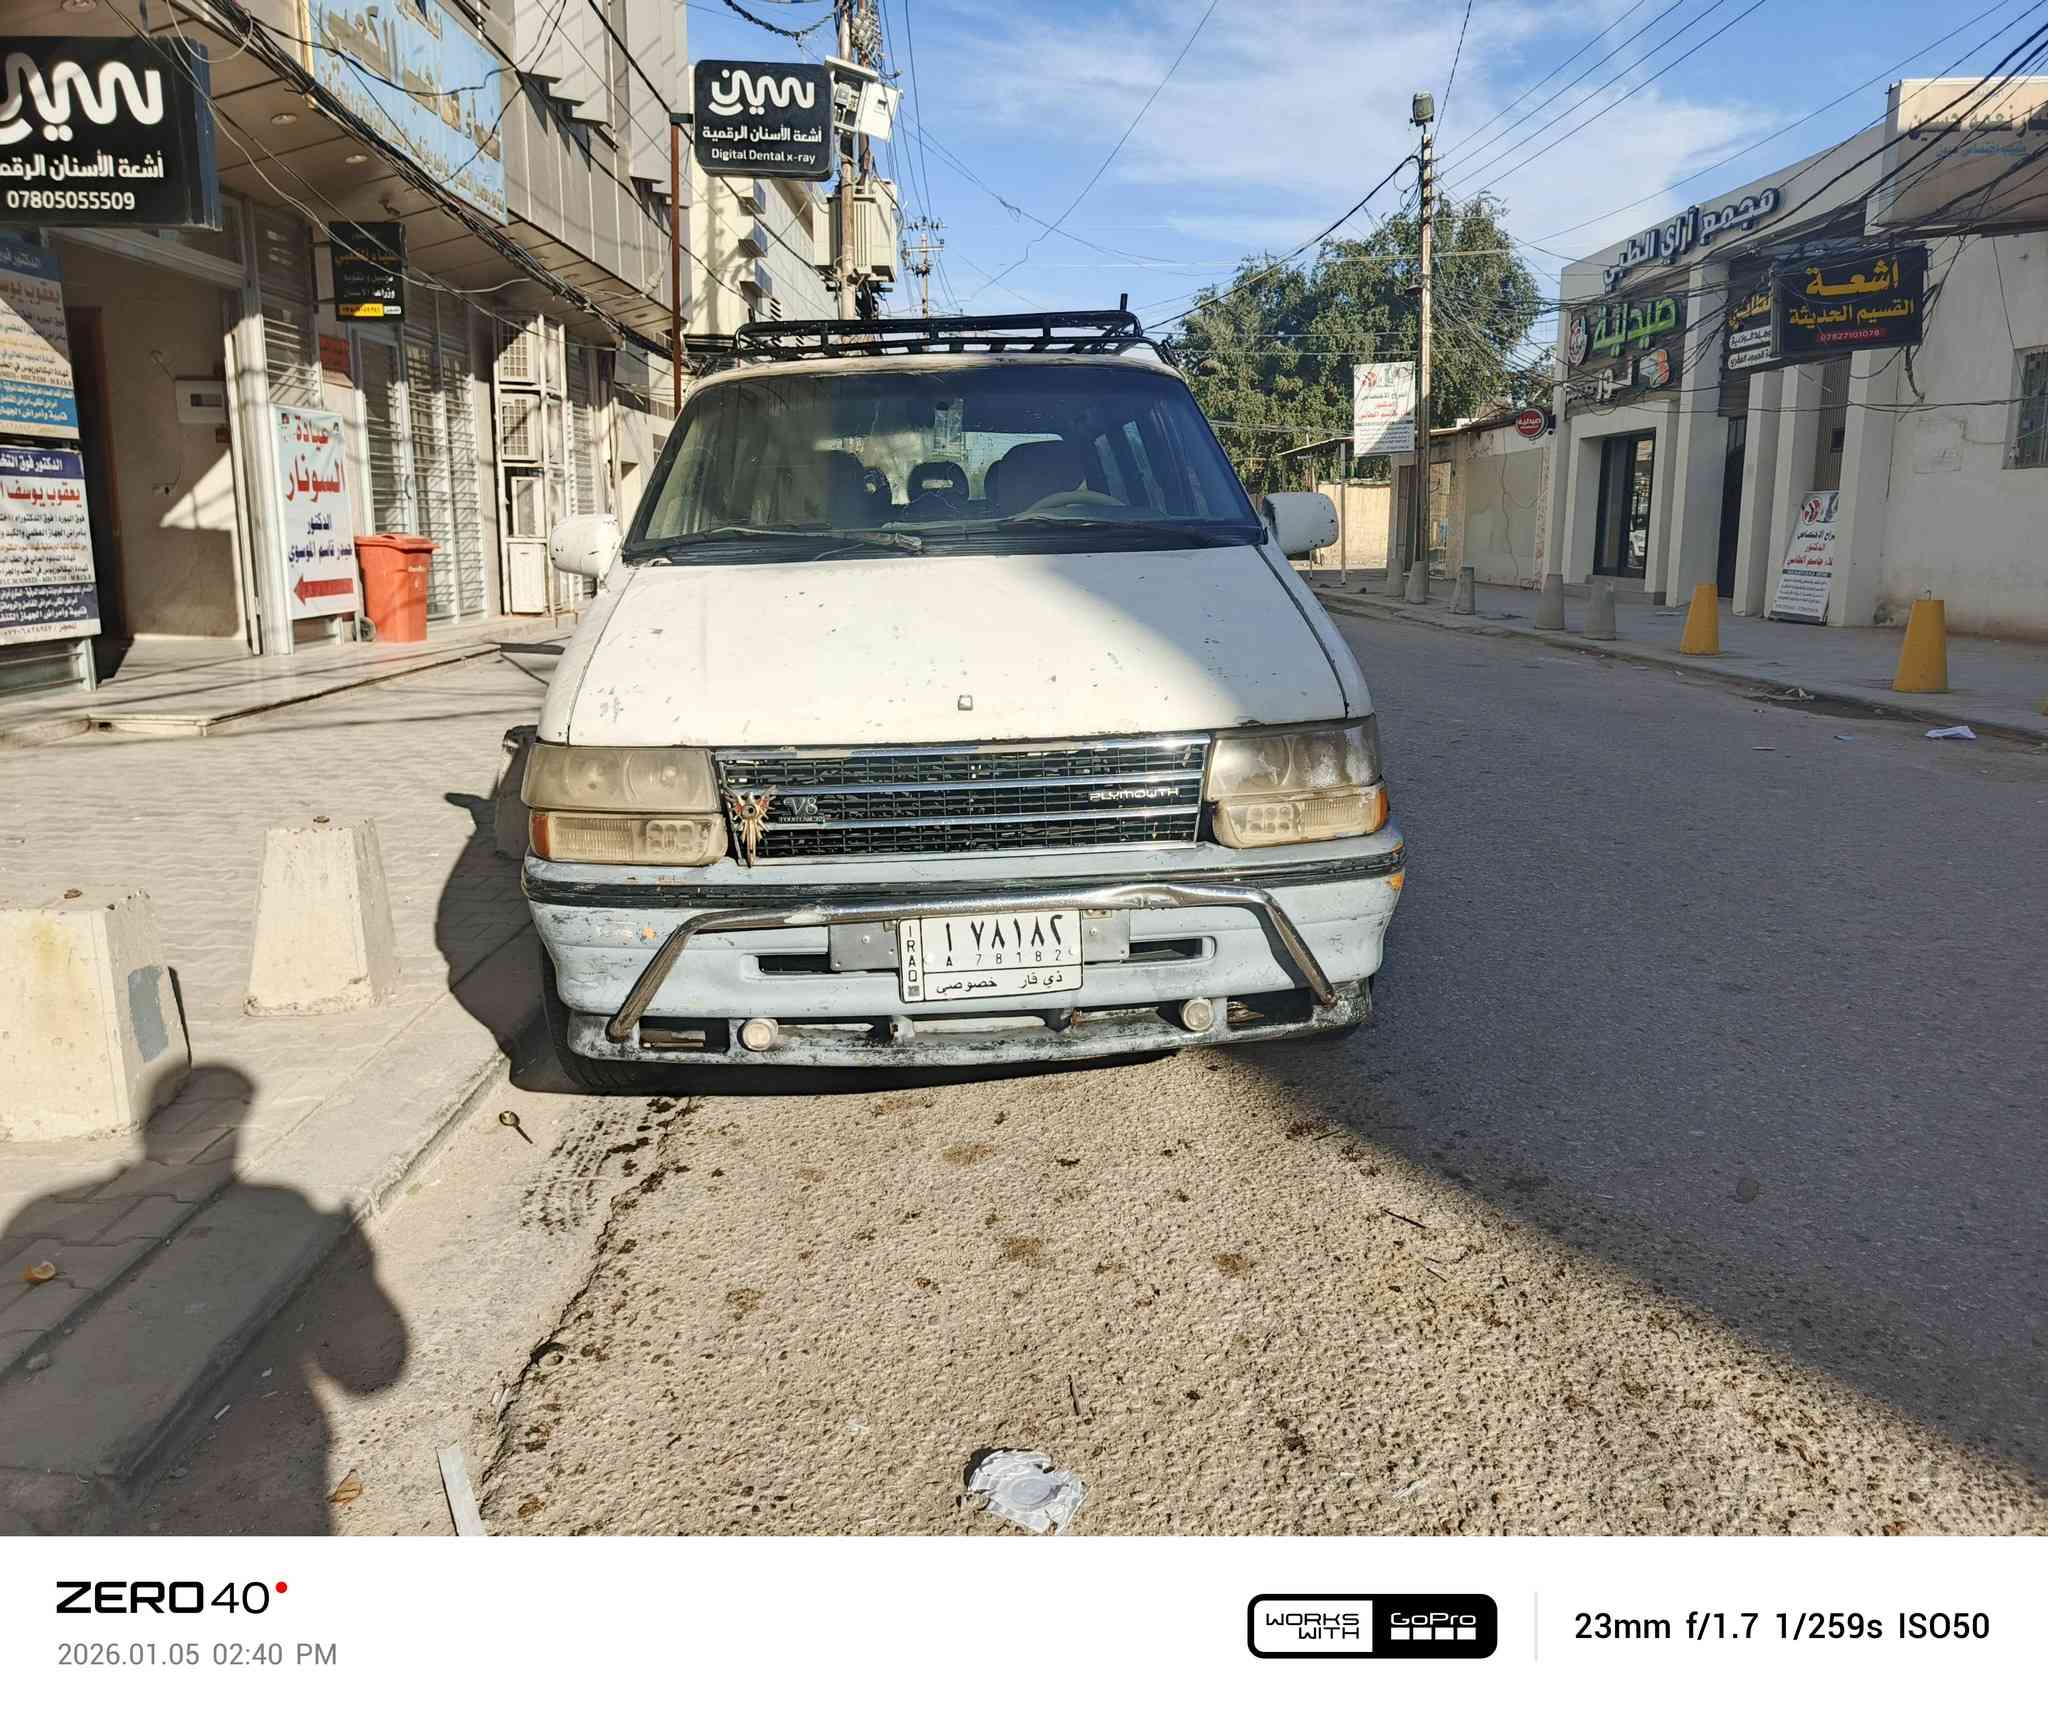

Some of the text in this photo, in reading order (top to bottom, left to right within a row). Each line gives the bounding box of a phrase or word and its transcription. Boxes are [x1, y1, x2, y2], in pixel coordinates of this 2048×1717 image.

[703, 124, 822, 143] أشعة الأسنان الرقمية
[50, 150, 113, 181] الأسنان
[118, 151, 163, 178] أشعة
[712, 148, 815, 164] Digital Dental x-ray
[7, 191, 136, 210] 07805055509
[1700, 187, 1780, 246] مجمع
[1601, 229, 1660, 295] الطبي
[1592, 298, 1679, 357] صيدلية
[286, 453, 346, 502] السونار
[7, 480, 46, 507] يوسف
[46, 482, 83, 508] يعقوب
[906, 925, 918, 983] IRAQ
[976, 949, 1062, 966] 78182
[936, 976, 998, 995] خصوصي
[1020, 970, 1064, 989] ذي قار
